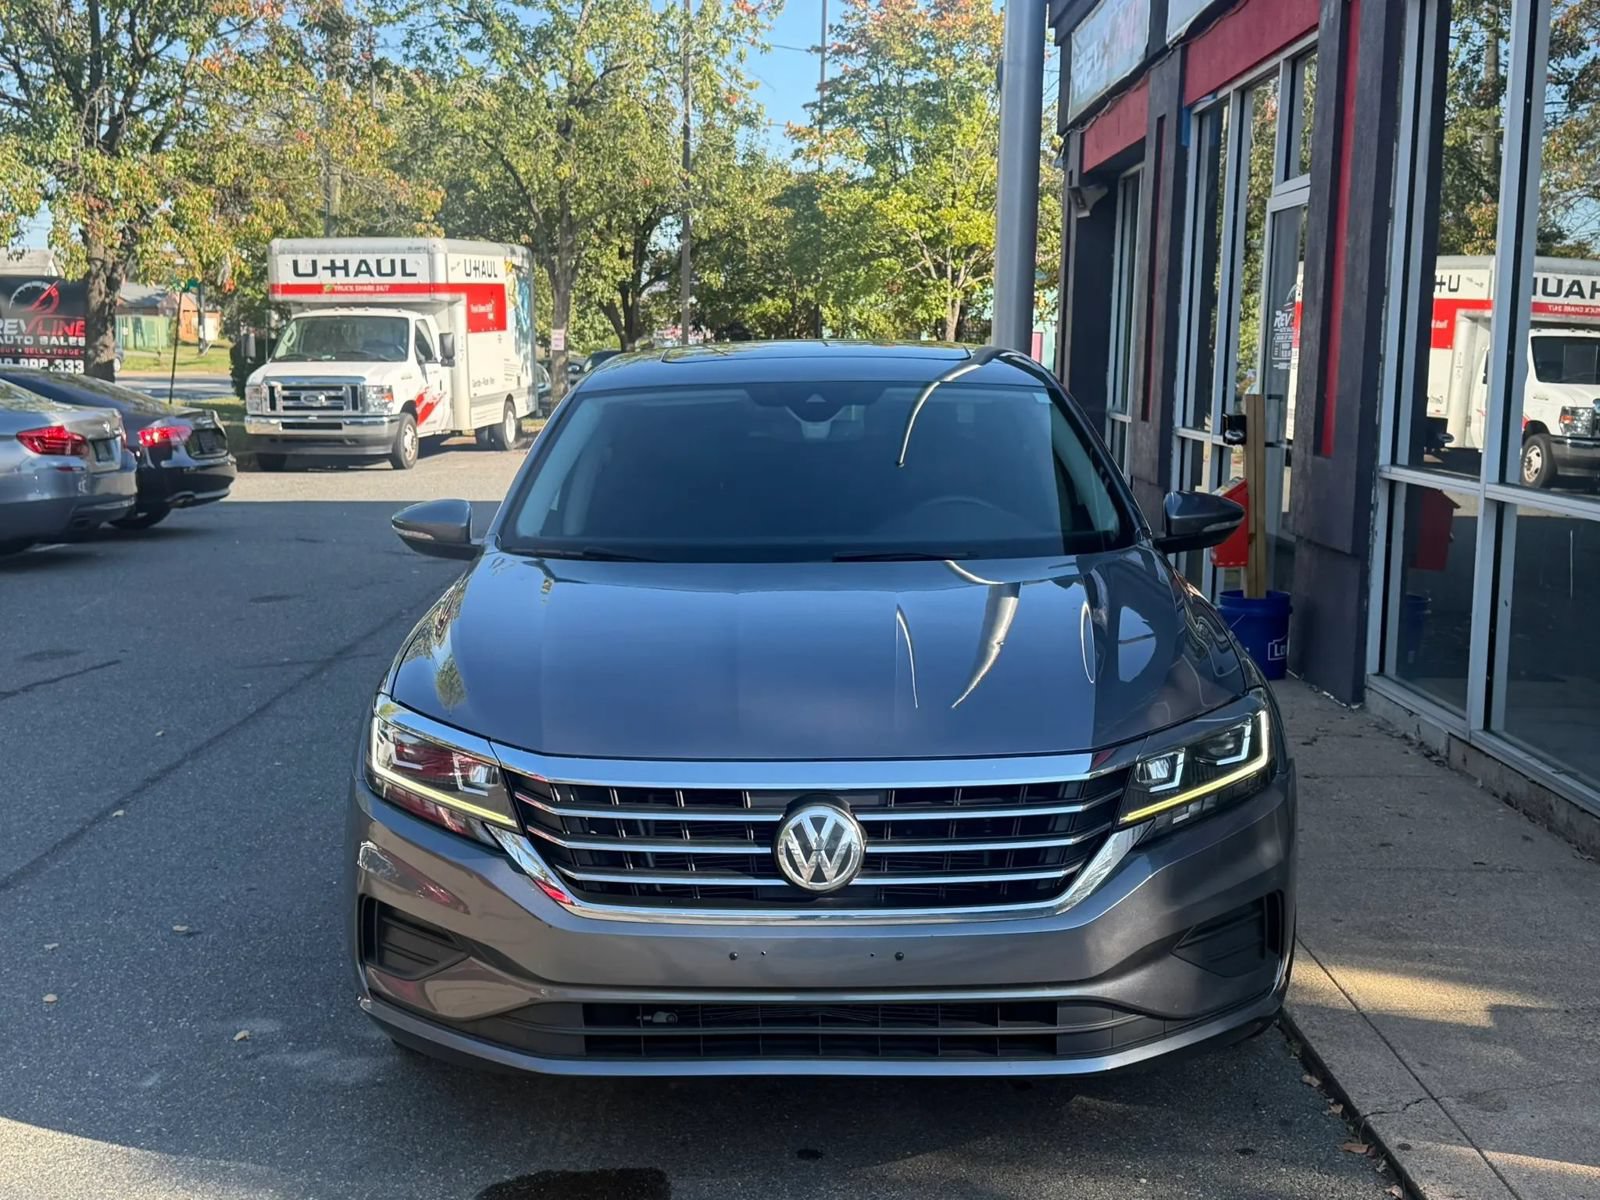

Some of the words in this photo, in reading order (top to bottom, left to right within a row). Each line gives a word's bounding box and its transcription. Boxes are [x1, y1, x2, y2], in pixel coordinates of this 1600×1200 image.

[292, 258, 417, 278] U-HAUL
[464, 258, 498, 278] U-HAUL
[0, 317, 86, 337] EVLINE
[40, 336, 86, 346] SALES
[53, 348, 80, 356] TRADE
